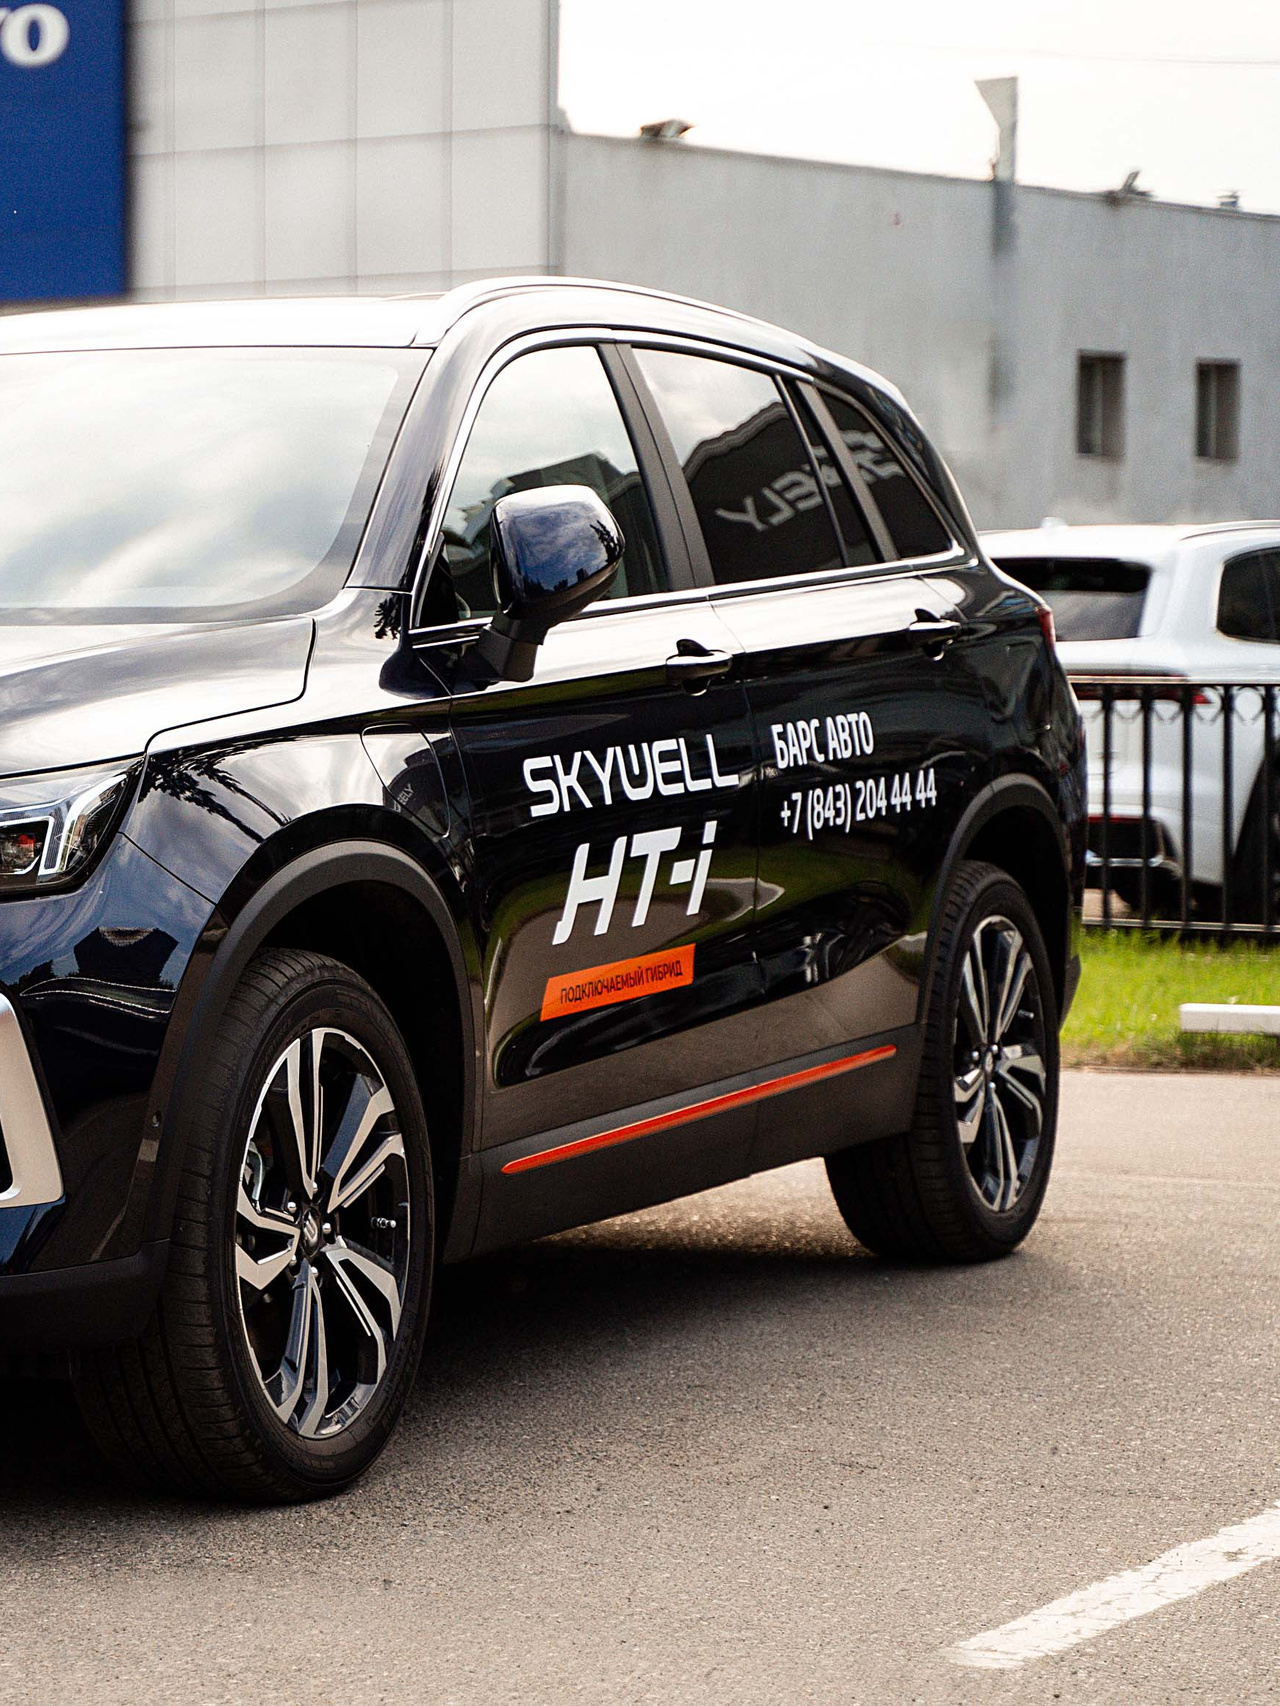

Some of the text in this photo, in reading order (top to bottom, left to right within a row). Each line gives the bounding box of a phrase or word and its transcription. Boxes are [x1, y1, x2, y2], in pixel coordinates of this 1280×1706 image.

[522, 733, 740, 818] SKYWELL
[771, 711, 874, 770] БАРС АВТО
[780, 767, 938, 841] +7 (843) 204 44 44
[552, 820, 718, 946] HT-i
[560, 959, 683, 1004] ПОДКЛЮЧАЕМЫЙ ГИБРИД
